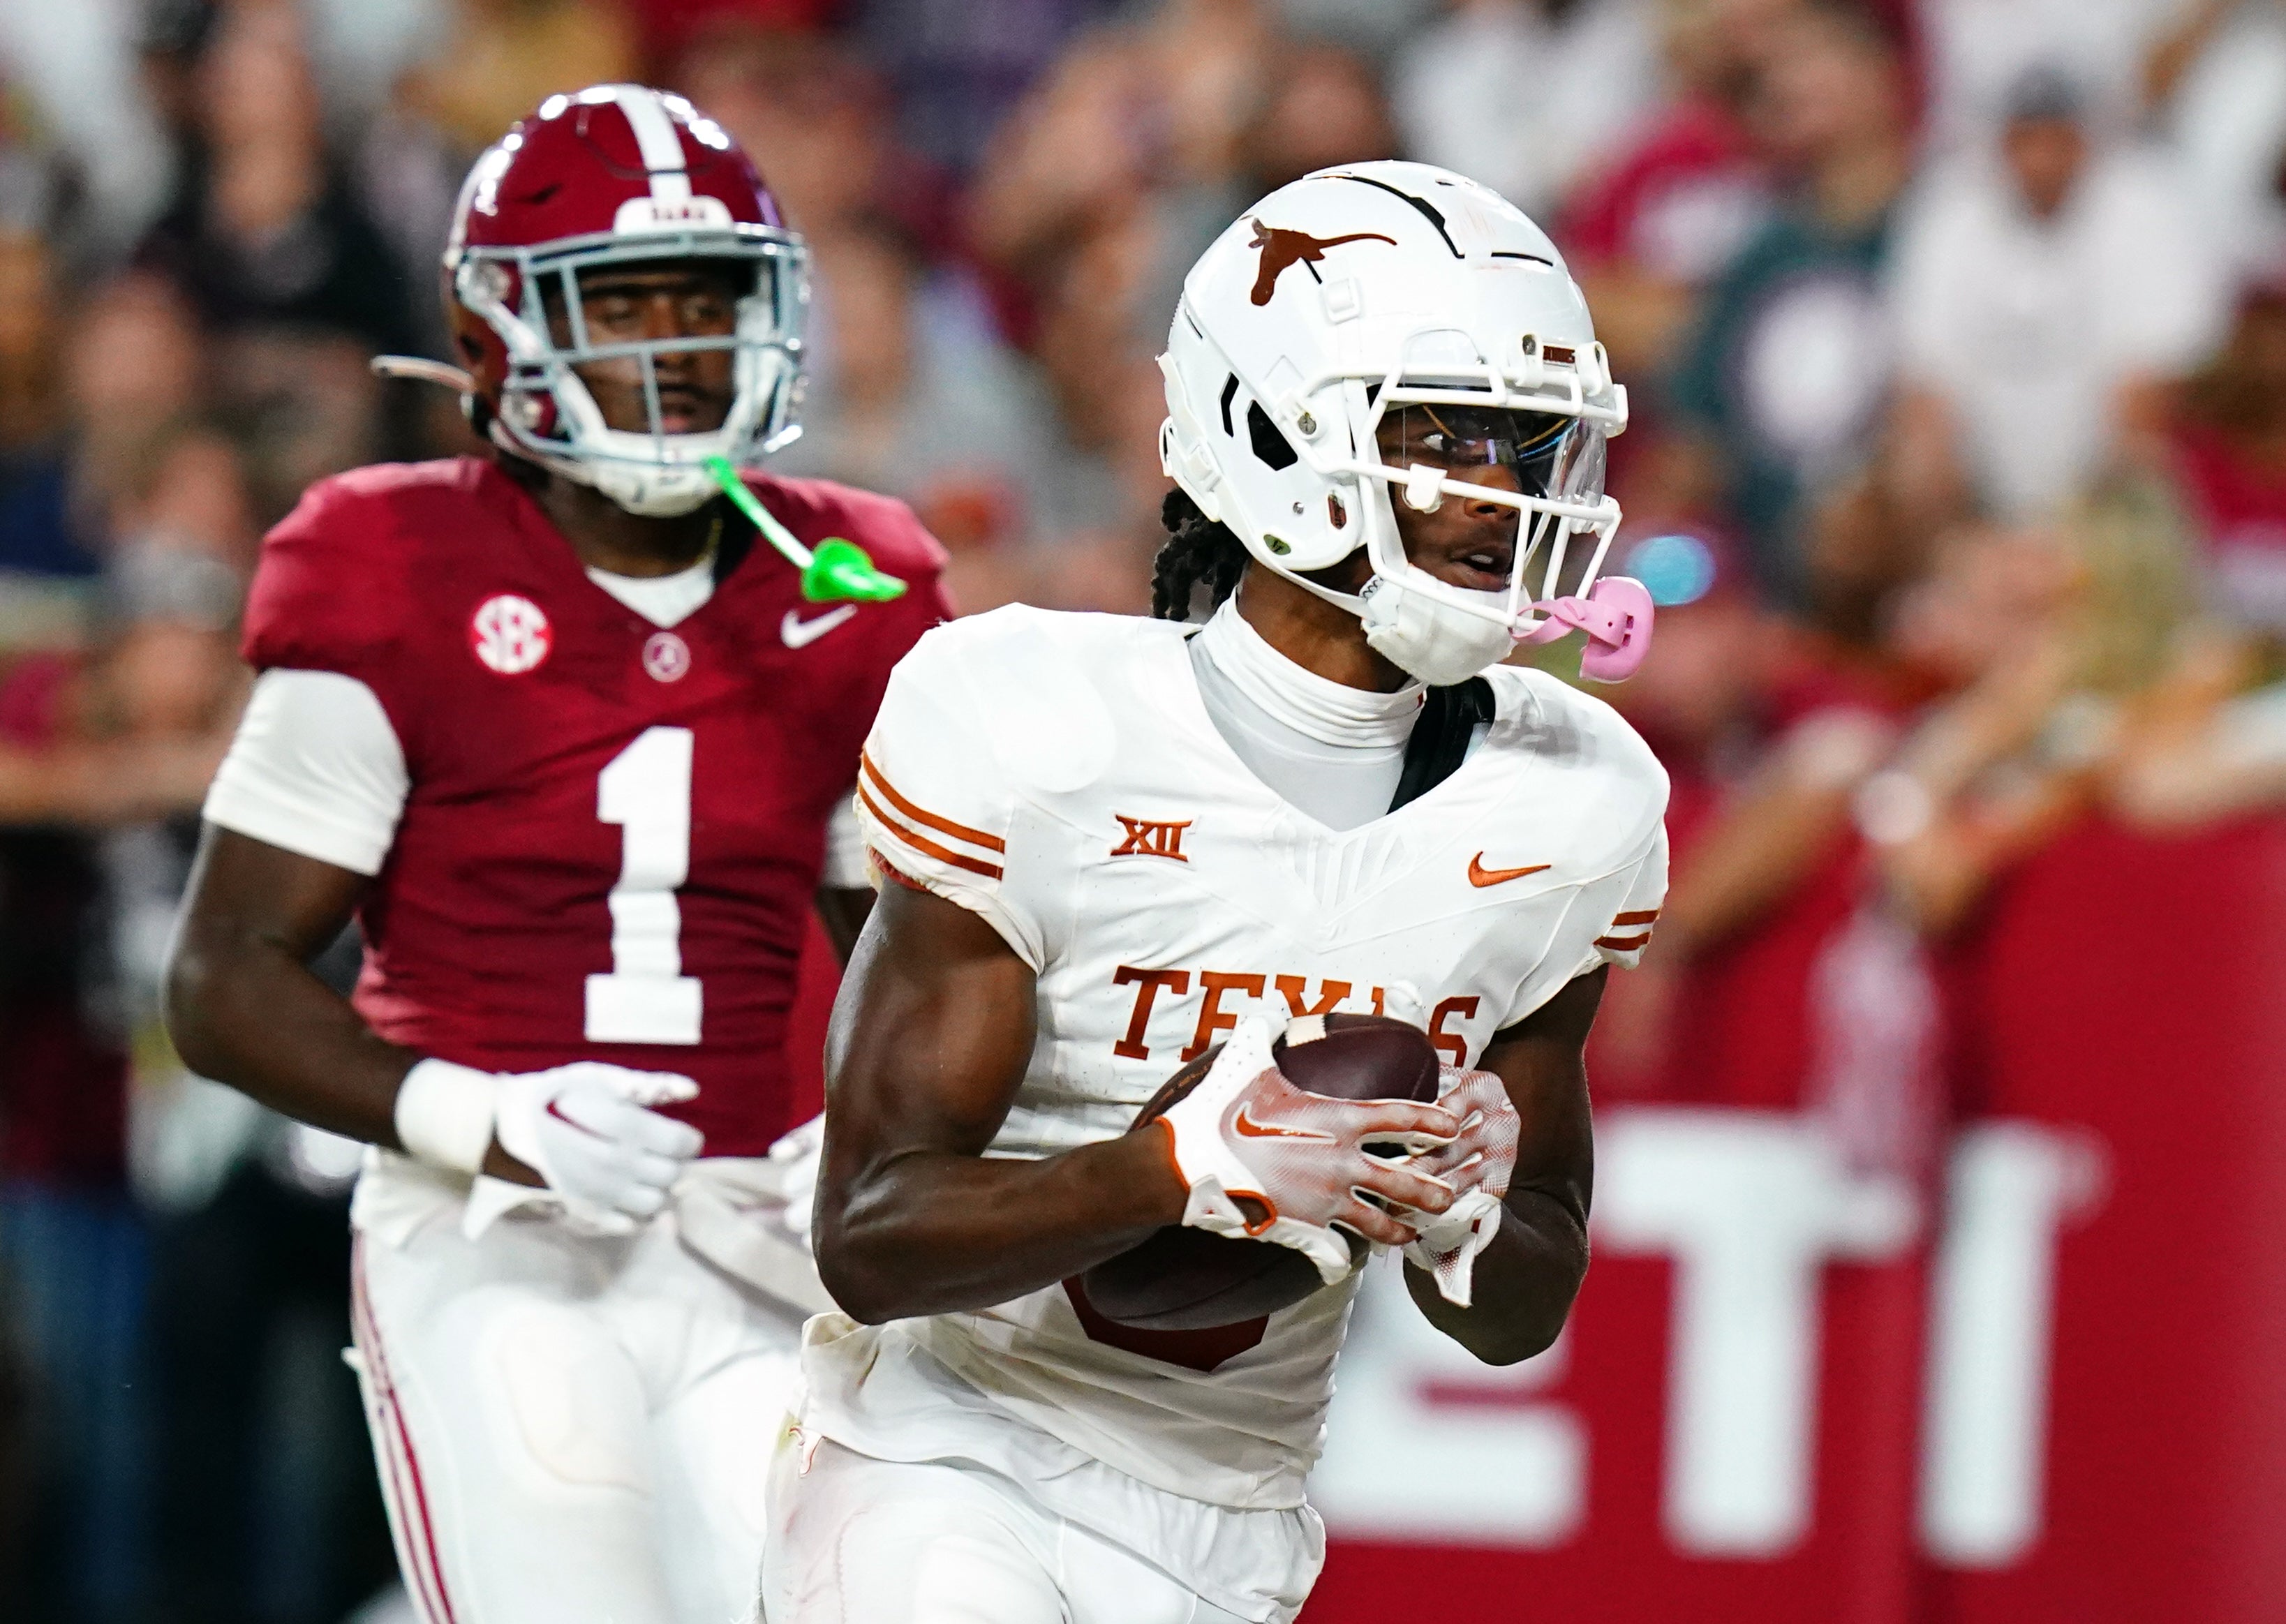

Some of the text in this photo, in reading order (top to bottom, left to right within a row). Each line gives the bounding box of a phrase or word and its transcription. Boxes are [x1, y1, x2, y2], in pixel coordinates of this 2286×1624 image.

[584, 725, 704, 1045] 1
[1110, 813, 1194, 863] XII
[1113, 964, 1481, 1069] TES
